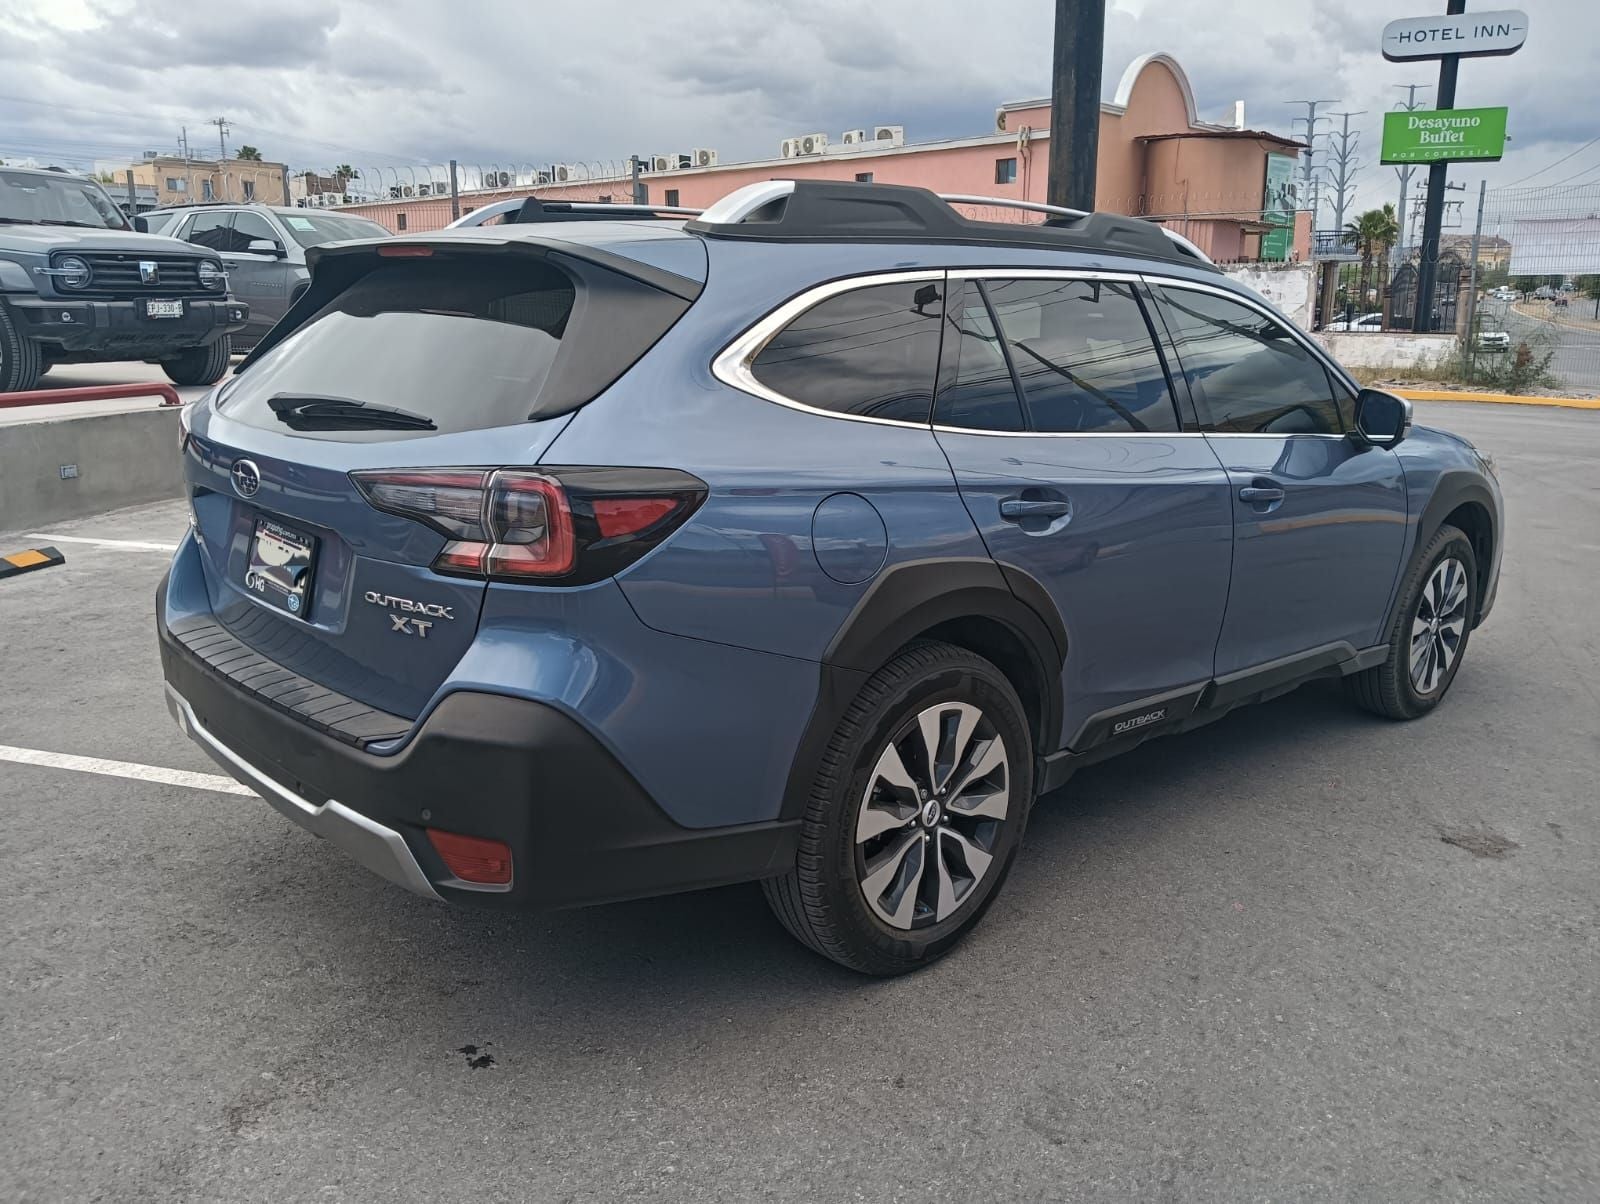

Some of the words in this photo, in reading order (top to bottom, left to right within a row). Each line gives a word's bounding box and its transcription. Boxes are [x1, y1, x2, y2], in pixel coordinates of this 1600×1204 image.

[1399, 28, 1464, 43] HOTEL
[1474, 24, 1510, 38] INN
[1408, 116, 1480, 130] Desayuno
[1420, 130, 1465, 143] Buffet
[364, 591, 455, 619] OUTBACK
[390, 614, 432, 637] XT
[1114, 709, 1166, 731] OUTBACK
